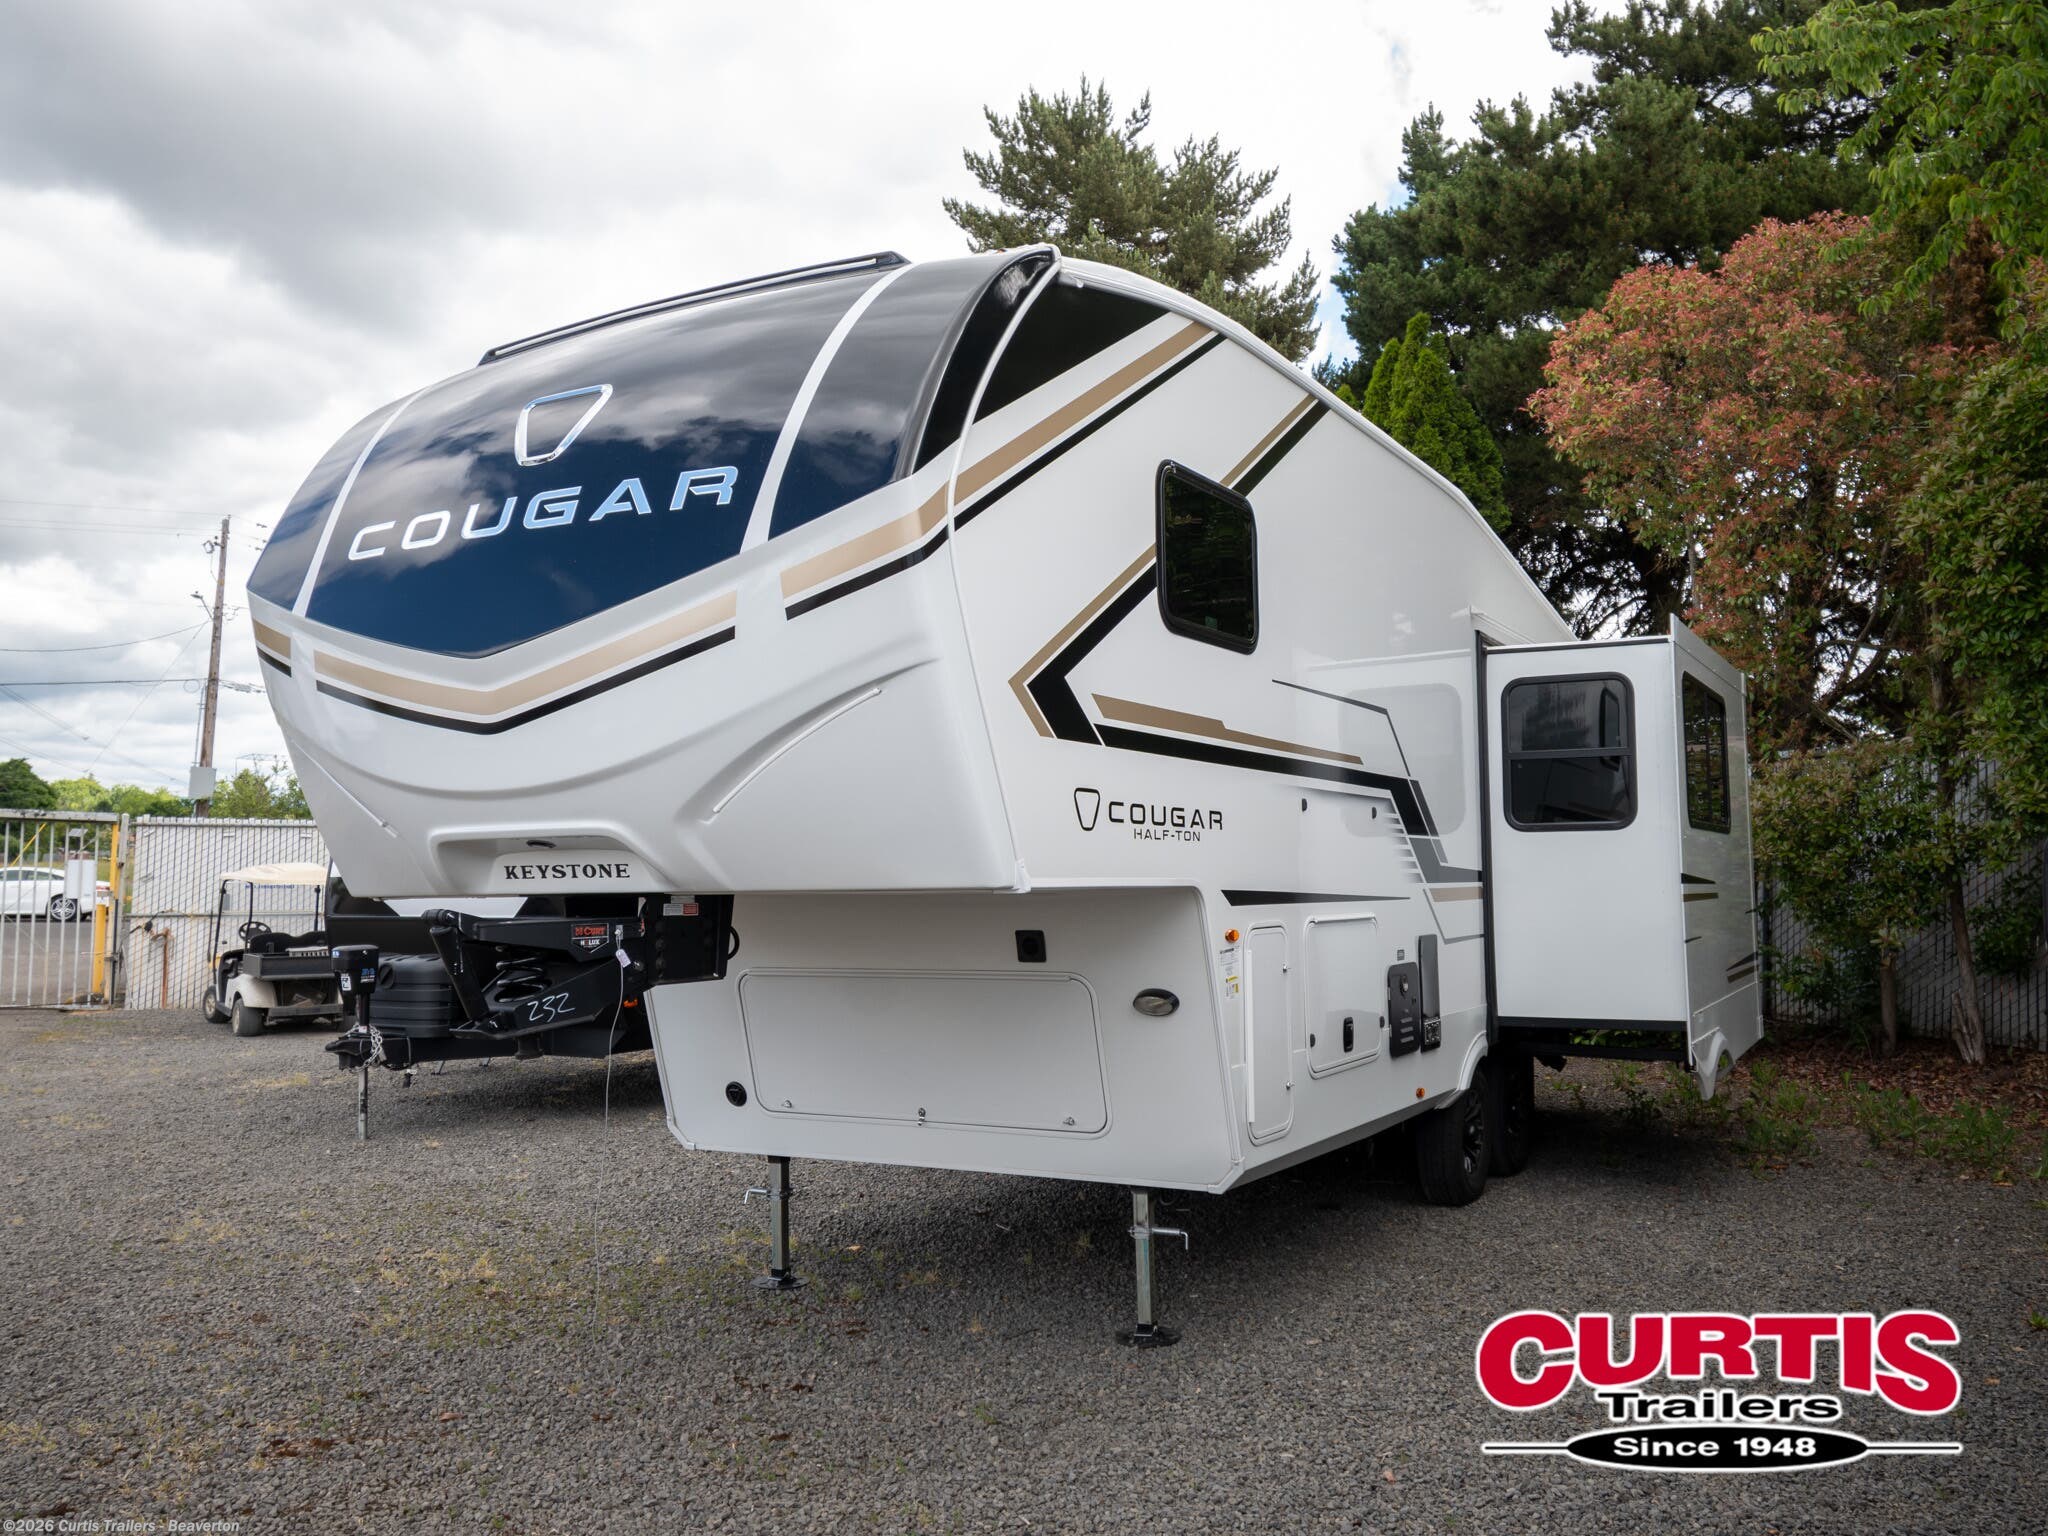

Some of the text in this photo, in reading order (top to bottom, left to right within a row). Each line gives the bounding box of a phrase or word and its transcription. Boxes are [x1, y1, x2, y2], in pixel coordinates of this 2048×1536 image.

[347, 465, 739, 561] COUGAR
[1108, 801, 1223, 830] COUGAR
[1133, 828, 1201, 842] HALF-TON
[503, 863, 631, 880] KEYSTONE
[527, 992, 576, 1023] 232
